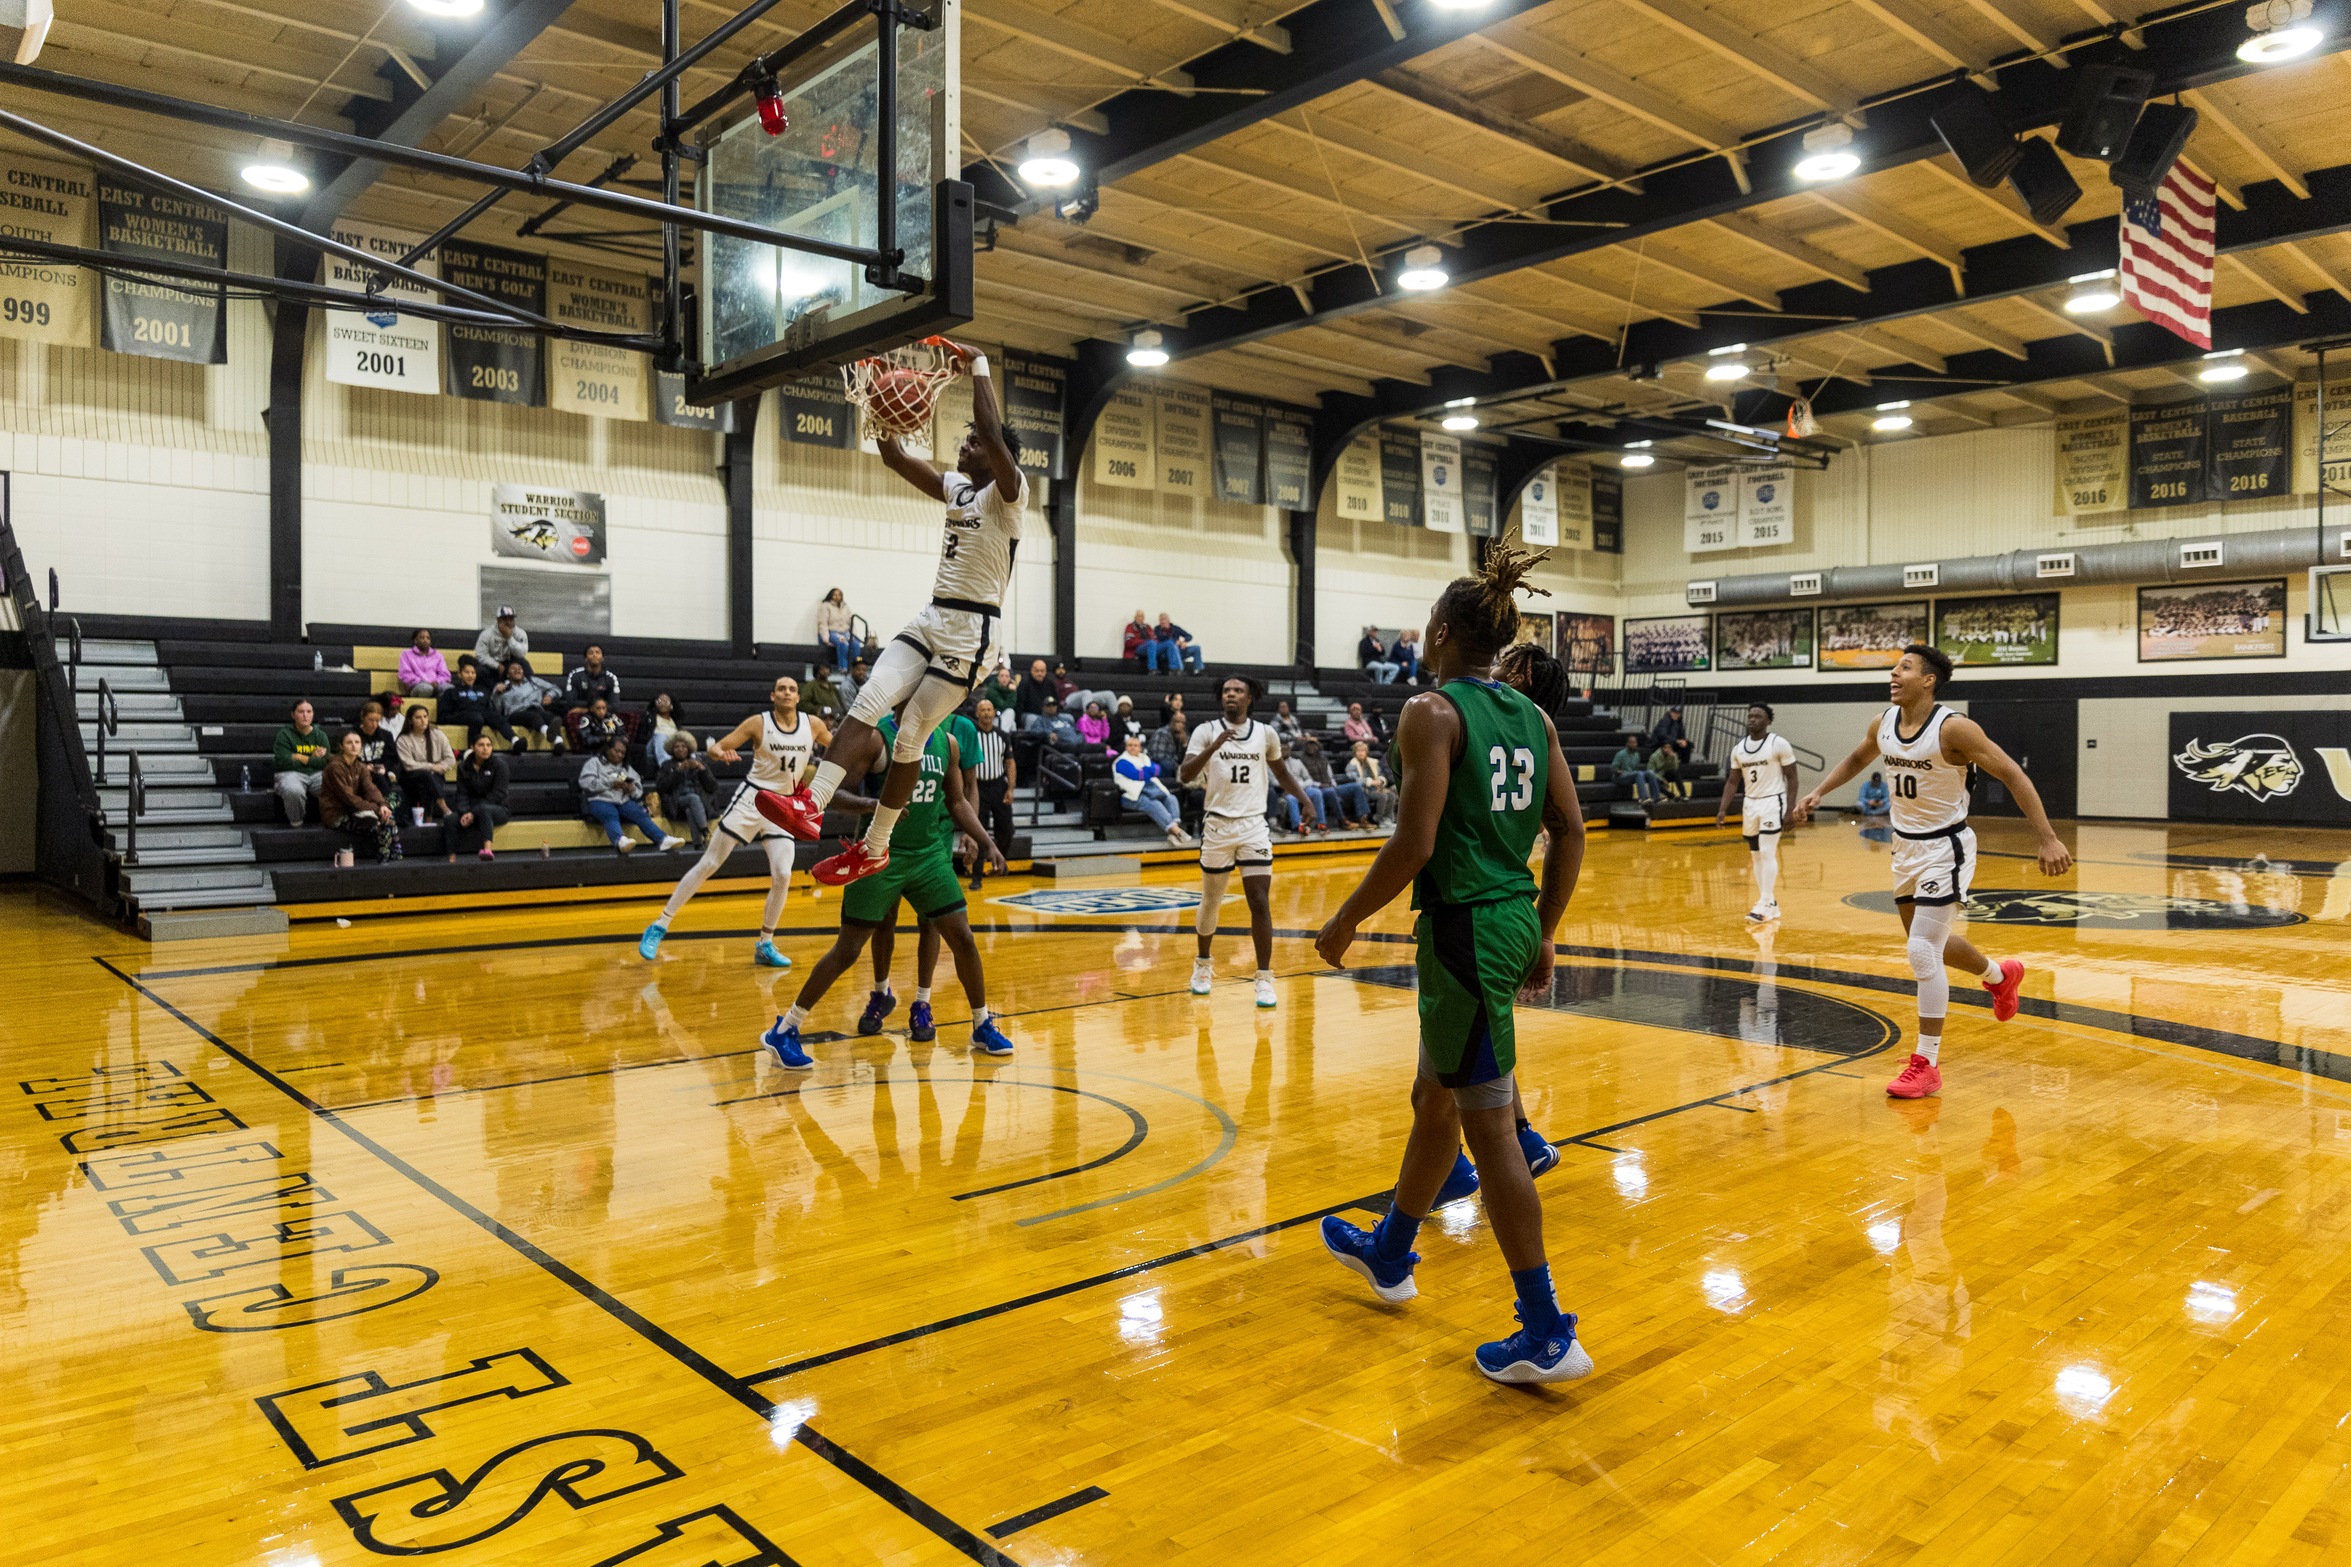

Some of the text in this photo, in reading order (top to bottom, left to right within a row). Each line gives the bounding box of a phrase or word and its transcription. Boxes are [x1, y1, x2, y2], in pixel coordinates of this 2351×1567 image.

[8, 170, 90, 198] CENTRAL
[100, 187, 227, 224] EAST CENTRAL
[125, 214, 203, 241] WOMEN'S
[110, 225, 218, 259] BASKETBALL
[370, 238, 435, 261] CENTL
[444, 250, 544, 281] EAST CENTRAL
[334, 266, 428, 294] BASKBALL
[453, 271, 536, 298] MEN'S GOLF
[552, 271, 584, 288] EAST
[590, 278, 645, 299] CENTRAL
[110, 281, 216, 308] CHAMPIONS
[570, 292, 628, 314] WOMEN'S
[4, 297, 50, 326] 999
[559, 304, 638, 328] BASKETBALL
[134, 317, 191, 348] 2001
[334, 328, 429, 351] SWEET SIXTEEN
[452, 326, 537, 349] CHAMPIONS
[570, 342, 627, 360] DIVISION
[357, 351, 405, 377] 2001
[560, 357, 637, 378] CHAMPIONS
[1005, 358, 1025, 372] EAST
[472, 365, 519, 392] 2003
[577, 380, 619, 405] 2004
[783, 384, 846, 405] CHAMPIONS
[2211, 392, 2292, 411] EAST CENTRAL
[2297, 389, 2325, 401] EAS
[2132, 403, 2207, 422] EAST CENTRAL
[2223, 408, 2278, 424] BASEBALL
[797, 412, 833, 437] 2004
[1007, 416, 1062, 435] CHAMPIONS
[1099, 437, 1147, 452] CHAMPIONS
[2136, 427, 2202, 444] BASKETBALL
[2232, 436, 2267, 448] STATE
[1019, 447, 1049, 469] 2005
[2151, 450, 2185, 462] STATE
[2216, 447, 2283, 462] CHAMPIONS
[1108, 459, 1136, 478] 2006
[1168, 467, 1194, 486] 2007
[2138, 460, 2201, 475] CHAMPIONS
[2150, 481, 2187, 499] 2016
[2230, 473, 2269, 492] 2016
[526, 493, 576, 508] WARRIOR
[1346, 496, 1367, 511] 2010
[2073, 489, 2107, 506] 2016
[501, 503, 599, 523] STUDENT SECTION
[1389, 502, 1410, 519] 2010
[1431, 509, 1449, 523] 2010
[1529, 524, 1545, 538] 2011
[1564, 528, 1581, 542] 2012
[1700, 532, 1724, 545] 2015
[1754, 525, 1779, 539] 2015
[945, 533, 959, 559] 2
[769, 743, 807, 753] WARRIORS
[1219, 751, 1260, 762] WARRIORS
[780, 755, 796, 773] 14
[1883, 754, 1933, 771] WARRIORS
[1230, 764, 1250, 784] 12
[1488, 744, 1536, 812] 23
[1750, 769, 1758, 783] 3
[912, 779, 937, 803] 22
[1894, 773, 1917, 800] 10
[18, 1058, 440, 1334] CENTRAL
